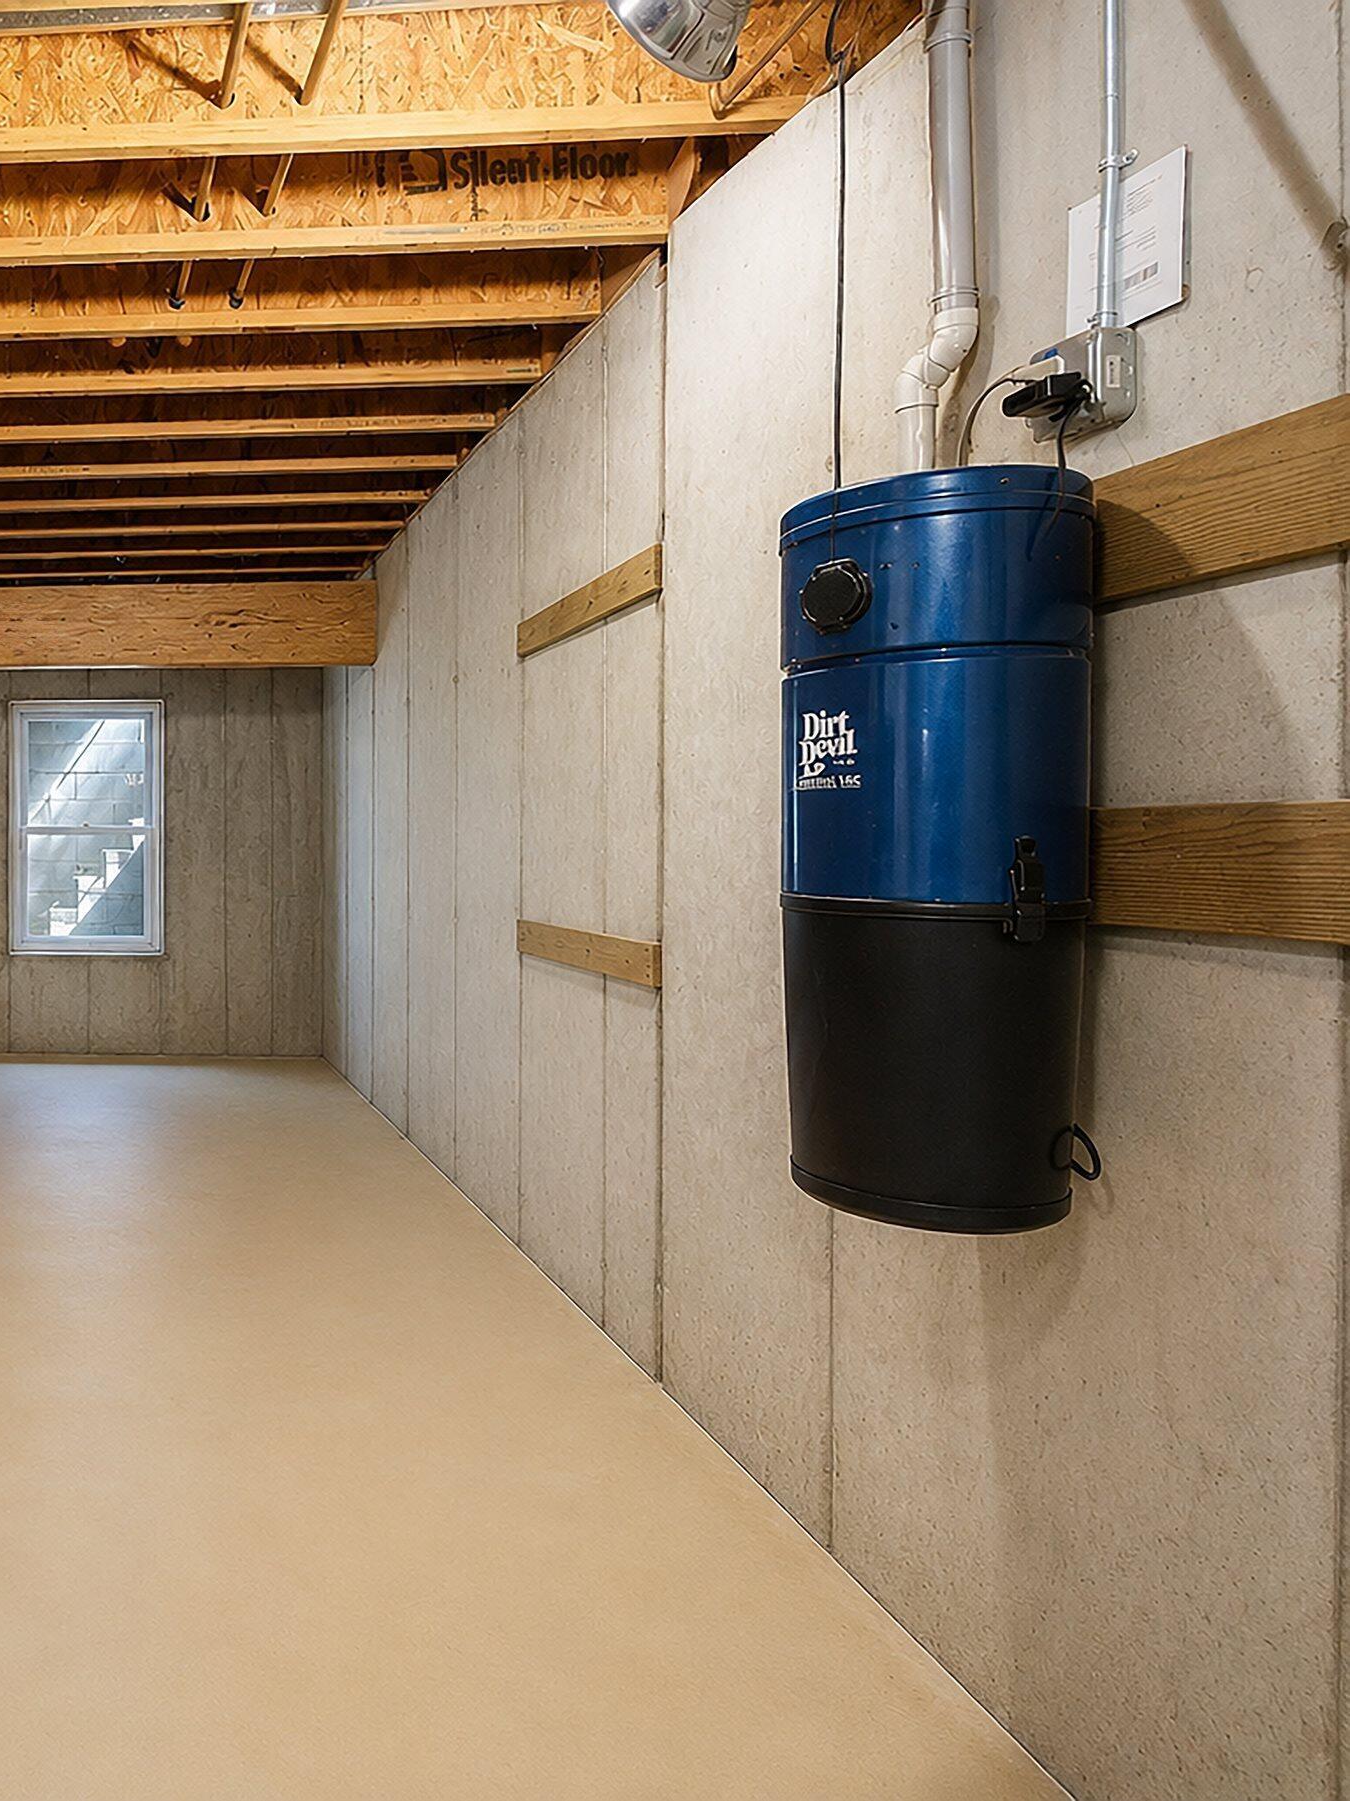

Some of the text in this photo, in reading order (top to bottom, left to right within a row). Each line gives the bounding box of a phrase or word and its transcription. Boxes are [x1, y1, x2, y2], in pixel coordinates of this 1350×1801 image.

[450, 149, 540, 190] Silent
[802, 710, 850, 741] Dirt
[798, 729, 858, 766] Devil
